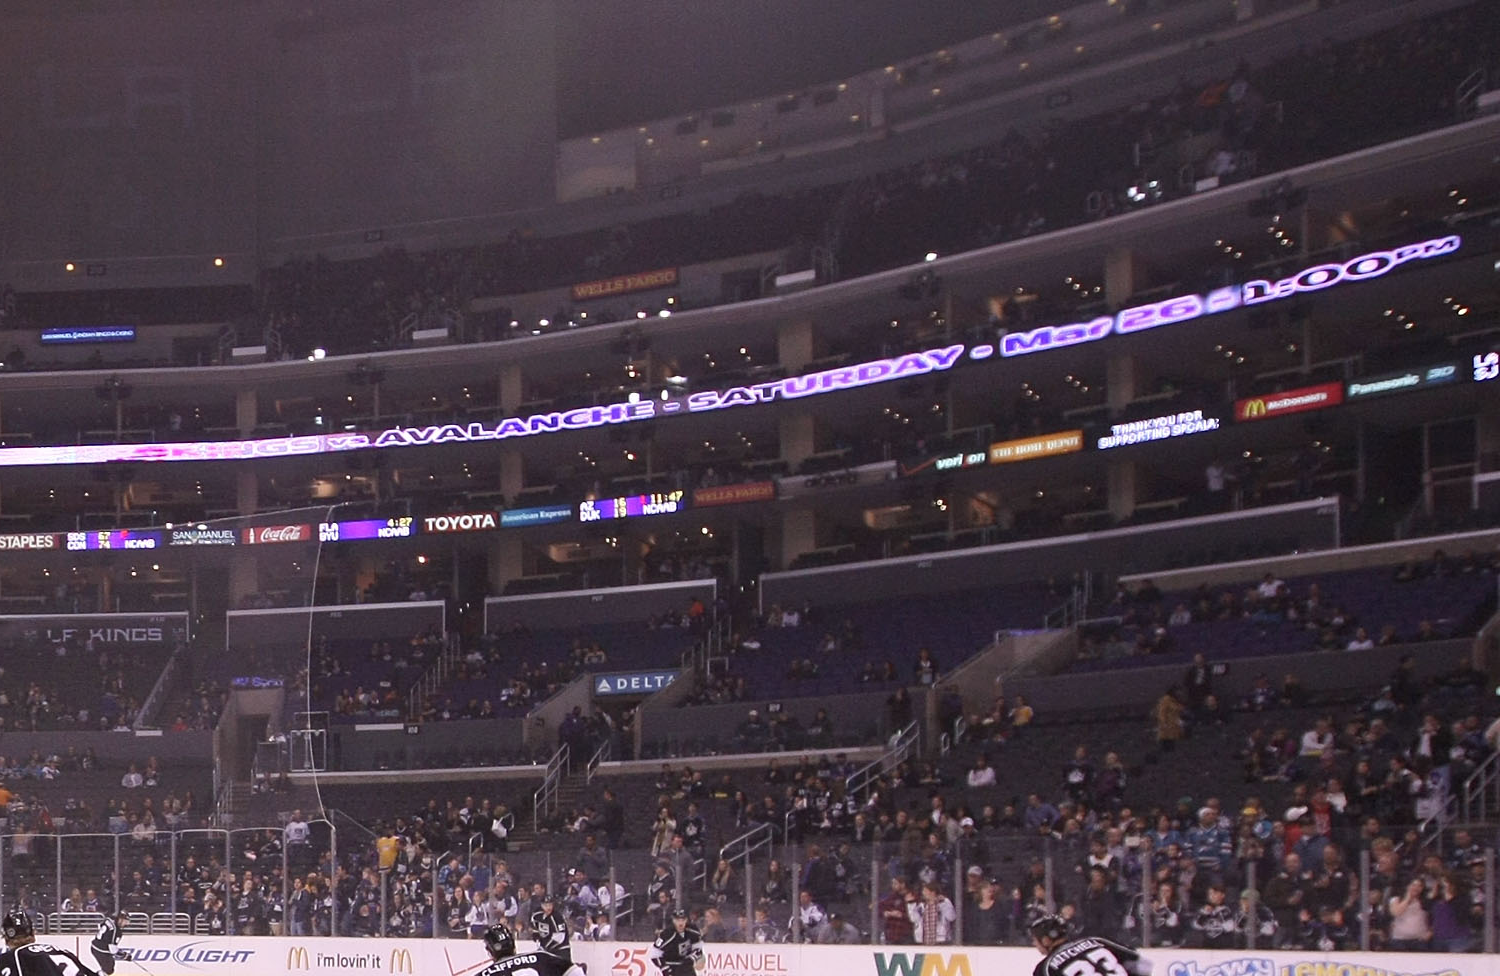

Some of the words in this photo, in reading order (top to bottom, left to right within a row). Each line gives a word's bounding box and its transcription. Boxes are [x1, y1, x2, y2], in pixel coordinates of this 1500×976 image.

[574, 278, 623, 298] WELLS
[375, 397, 654, 448] AVALANCHE
[689, 344, 965, 413] SATURDAY
[1001, 315, 1114, 357] Mar
[1117, 293, 1201, 335] 26
[1349, 373, 1420, 397] Panasonic
[1267, 392, 1328, 410] McDonald's
[1111, 419, 1148, 435] THANK
[1148, 414, 1176, 429] YOU
[1177, 410, 1203, 424] FOR
[1097, 428, 1171, 450] SUPPORTING
[386, 517, 413, 528] 4:27
[424, 514, 496, 532] TOYOTA
[502, 510, 538, 523] American
[539, 507, 572, 520] Express
[172, 530, 191, 540] SAN
[198, 530, 235, 540] MANUEL
[260, 525, 301, 541] Coca-Cola
[89, 627, 163, 643] KINGS
[182, 950, 255, 964] LIGHT
[707, 954, 788, 972] MANUEL
